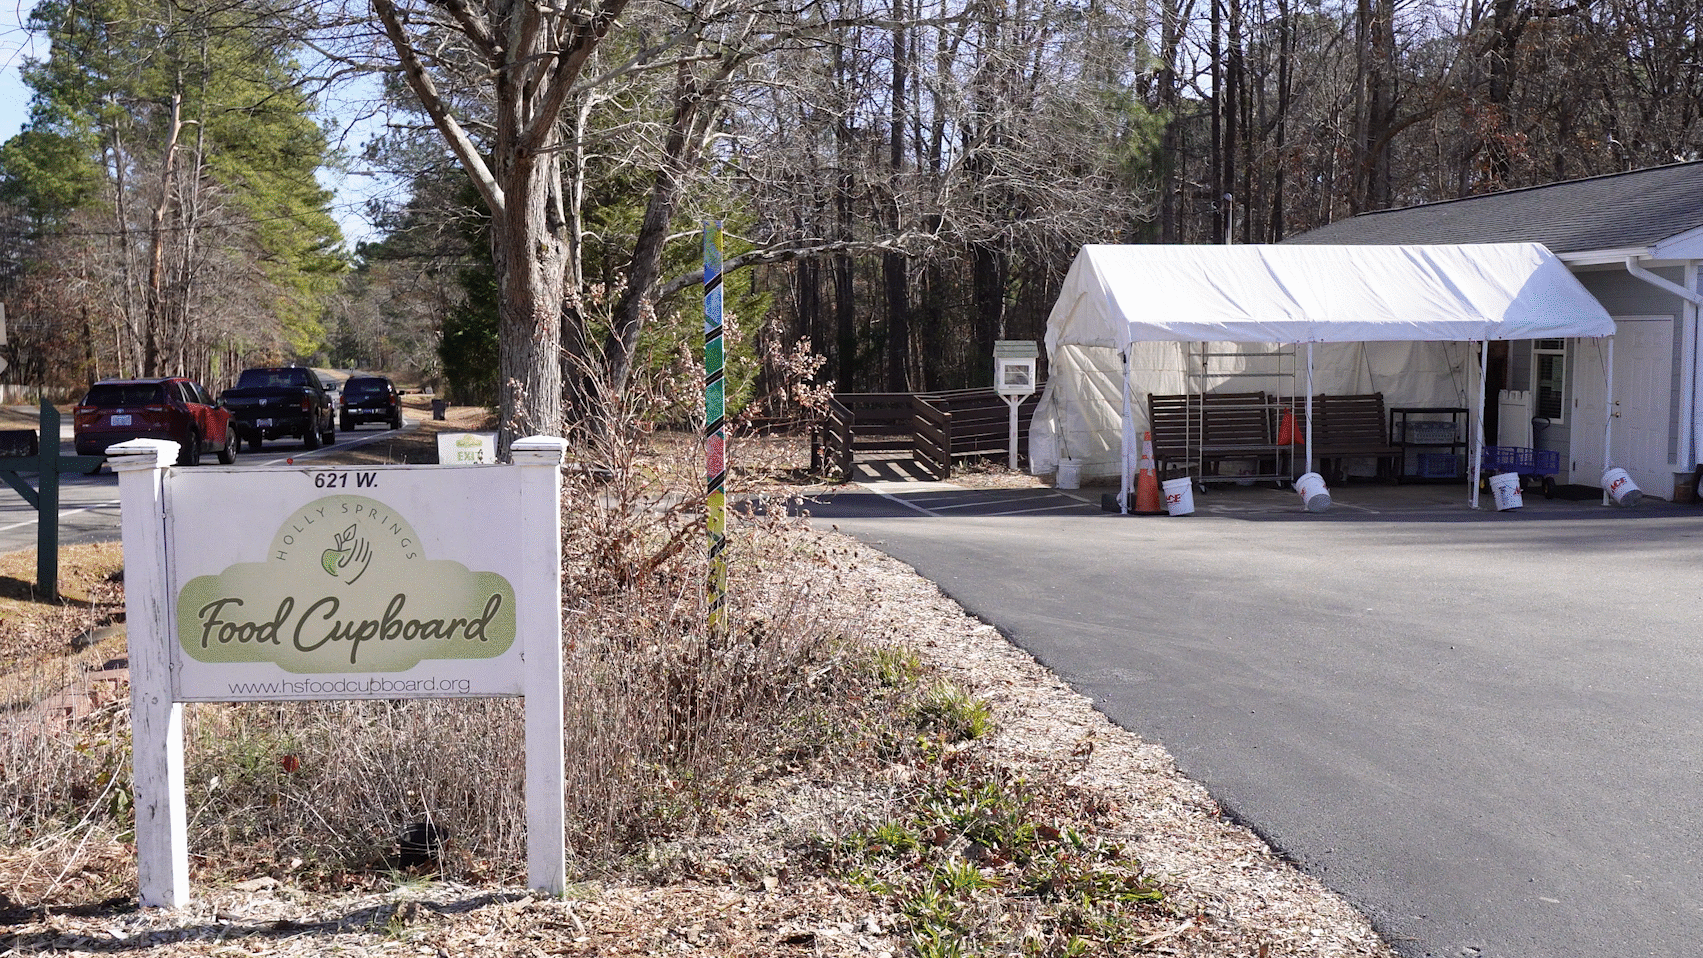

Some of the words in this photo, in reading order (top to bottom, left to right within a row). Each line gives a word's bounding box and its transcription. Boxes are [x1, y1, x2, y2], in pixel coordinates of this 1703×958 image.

[457, 451, 483, 461] EXIT
[314, 472, 348, 488] 621
[356, 472, 378, 488] W.
[276, 507, 325, 561] HOLLY
[341, 503, 417, 560] SPRINGS
[198, 596, 295, 648] Food
[293, 593, 502, 664] Cupboard
[228, 677, 470, 693] www.hsfoodcupboard.org
